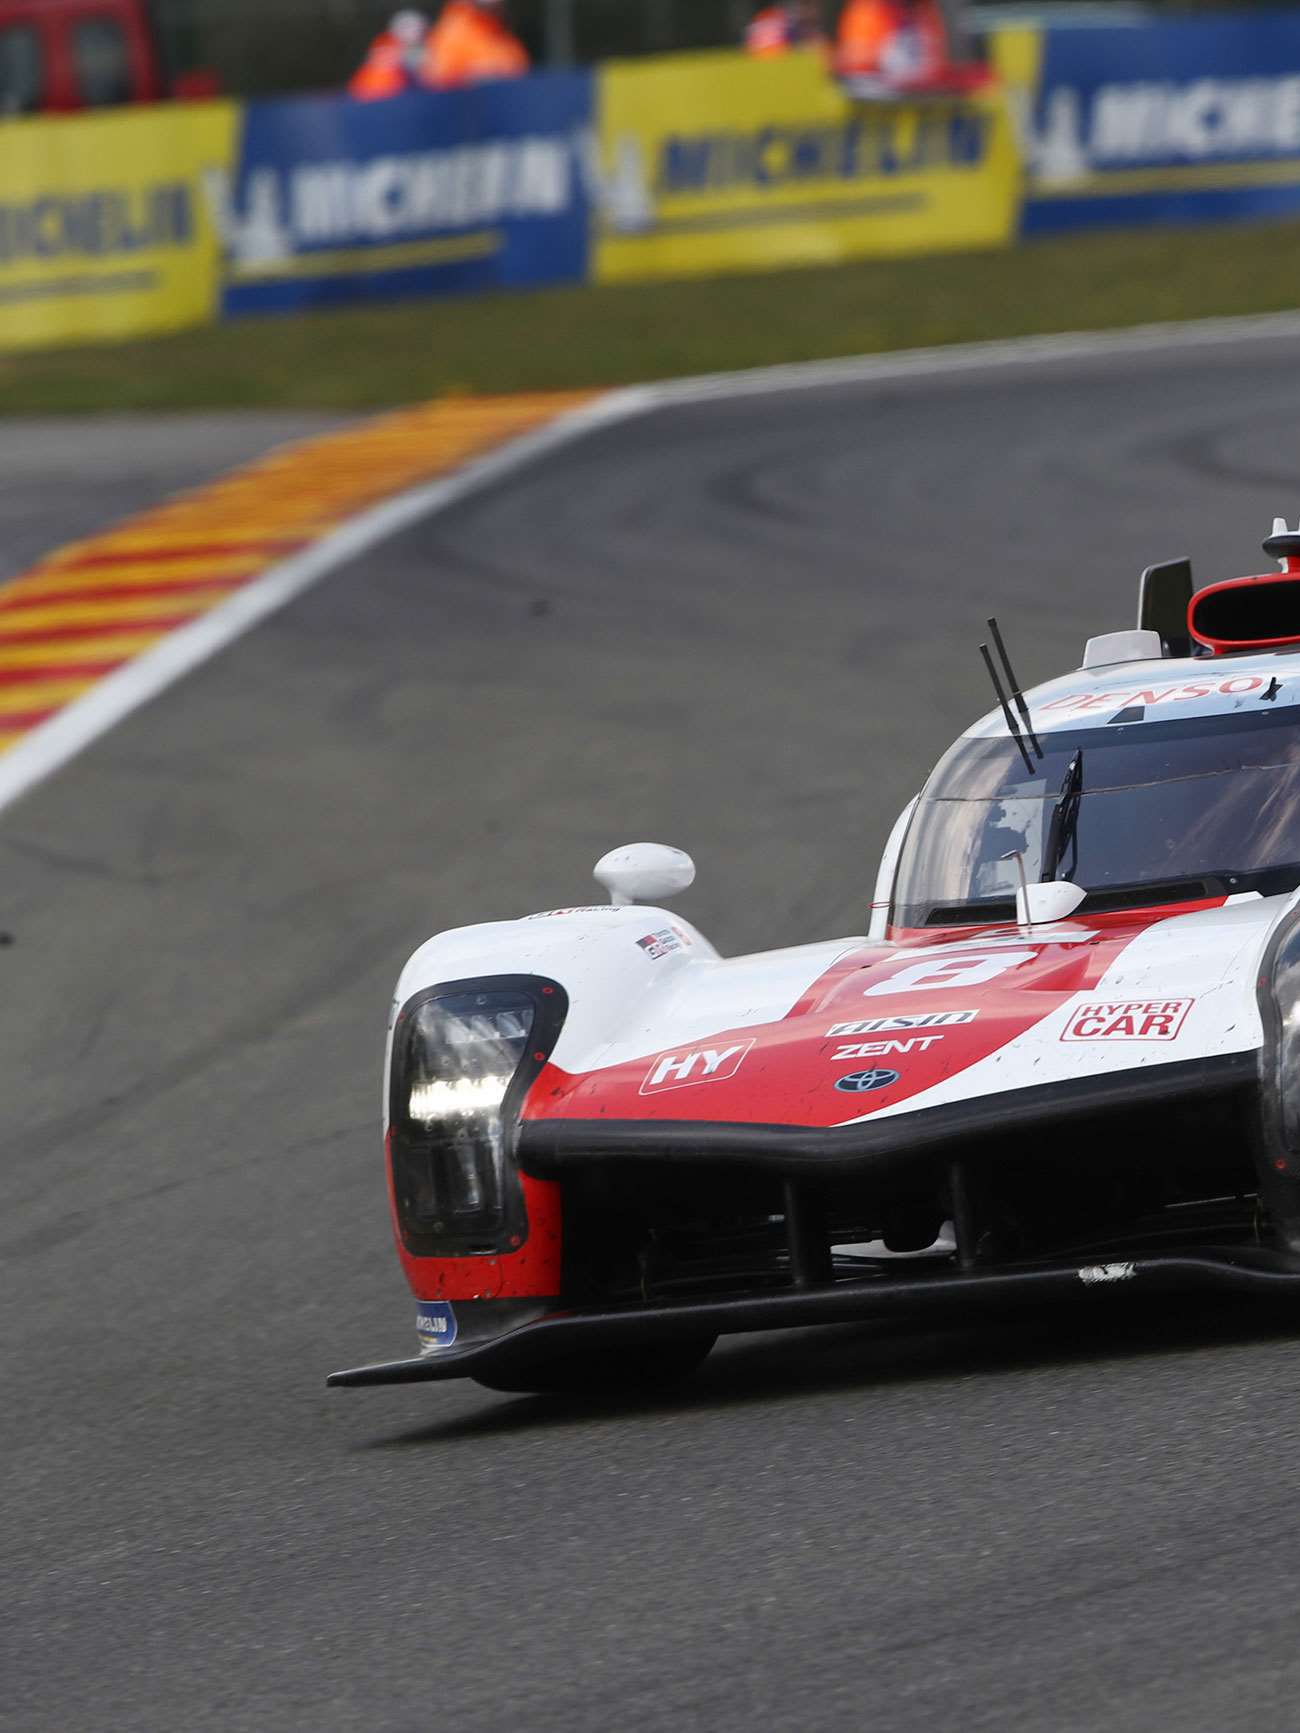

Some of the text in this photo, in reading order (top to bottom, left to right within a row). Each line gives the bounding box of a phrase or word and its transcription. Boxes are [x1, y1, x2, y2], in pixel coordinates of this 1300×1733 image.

[661, 105, 992, 193] MICHELIN
[291, 136, 572, 238] MICHELIN
[0, 184, 193, 262] ICHELIN
[1040, 676, 1264, 711] DENSO
[863, 951, 1039, 997] 8
[831, 1012, 972, 1036] AISIN
[1072, 1015, 1175, 1037] CAR
[1081, 1002, 1183, 1017] HYPER
[649, 1045, 745, 1085] HY
[830, 1035, 945, 1061] ZENT
